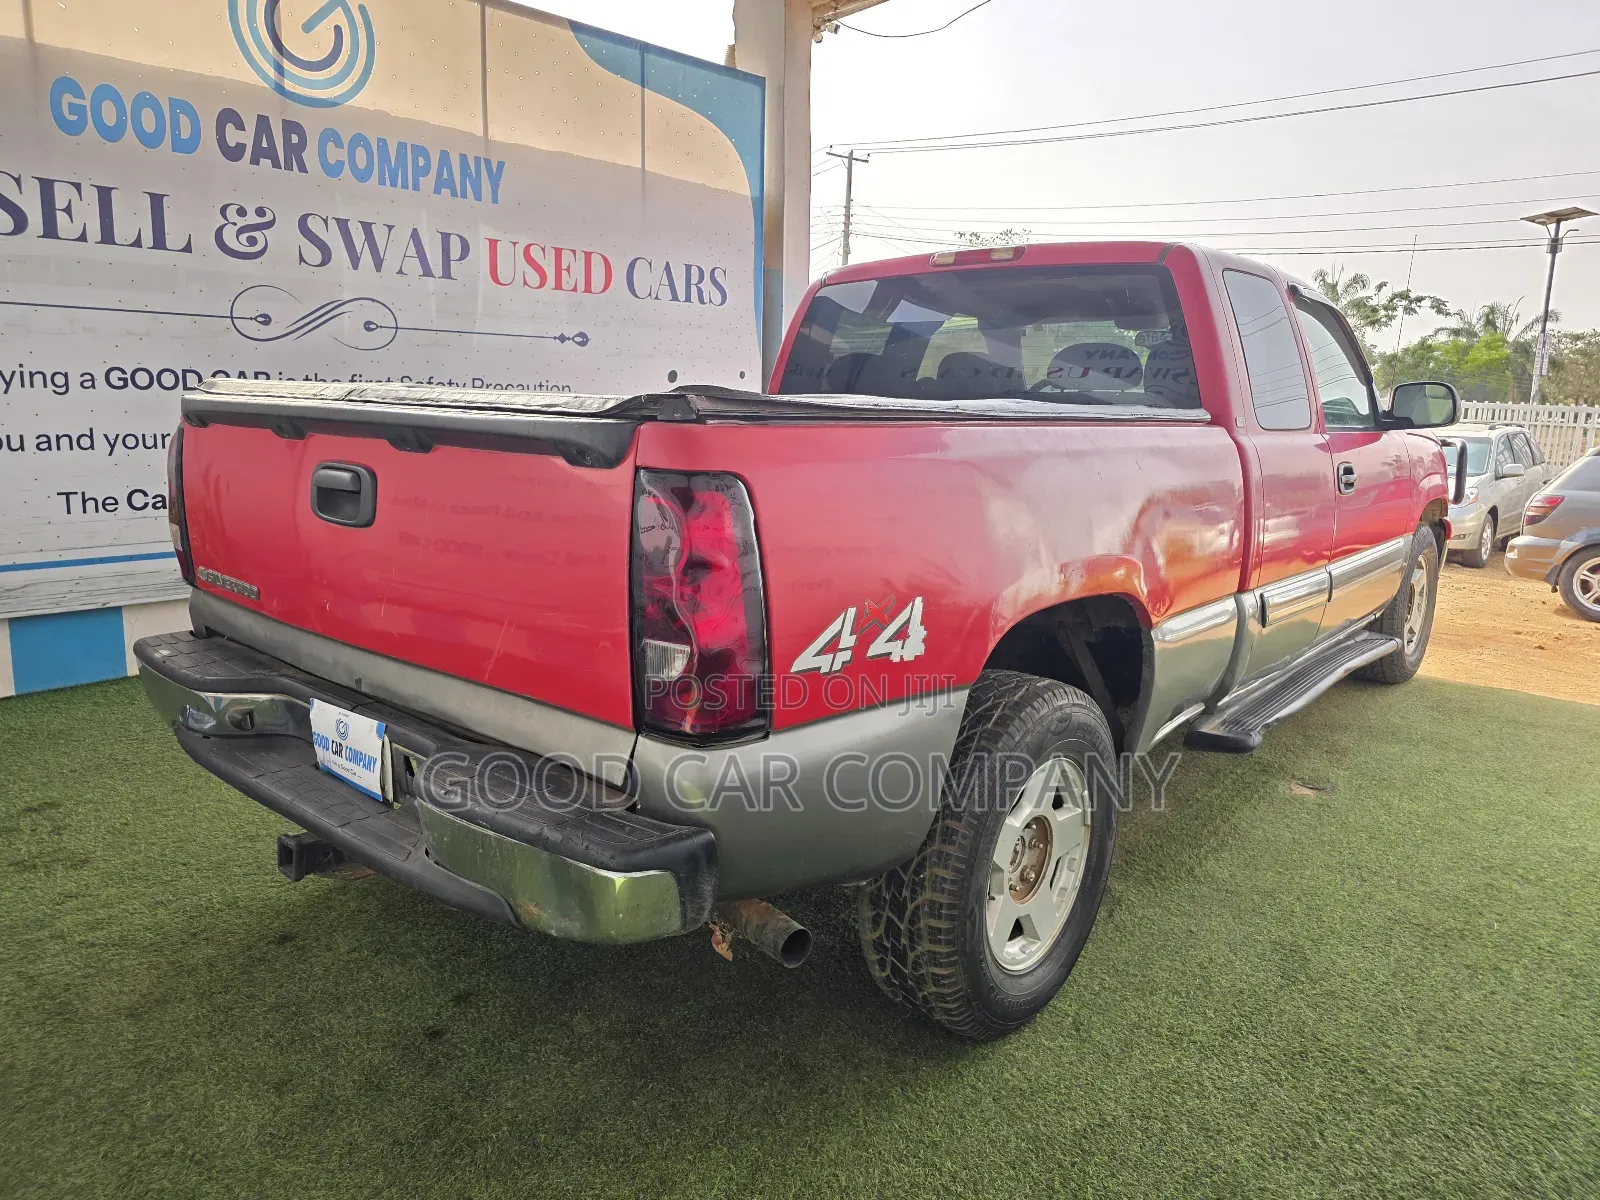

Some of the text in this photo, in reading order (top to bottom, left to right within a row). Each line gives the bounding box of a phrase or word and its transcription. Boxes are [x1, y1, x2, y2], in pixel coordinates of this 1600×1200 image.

[48, 75, 506, 205] GOOD CAR COMPANY
[0, 170, 729, 307] SELL & SWAP USED CARS
[79, 371, 97, 390] a
[104, 366, 204, 391] GOOD
[35, 427, 96, 452] and
[102, 432, 171, 457] your
[56, 490, 119, 515] The
[331, 739, 344, 759] CAR
[344, 745, 378, 774] COMPANY
